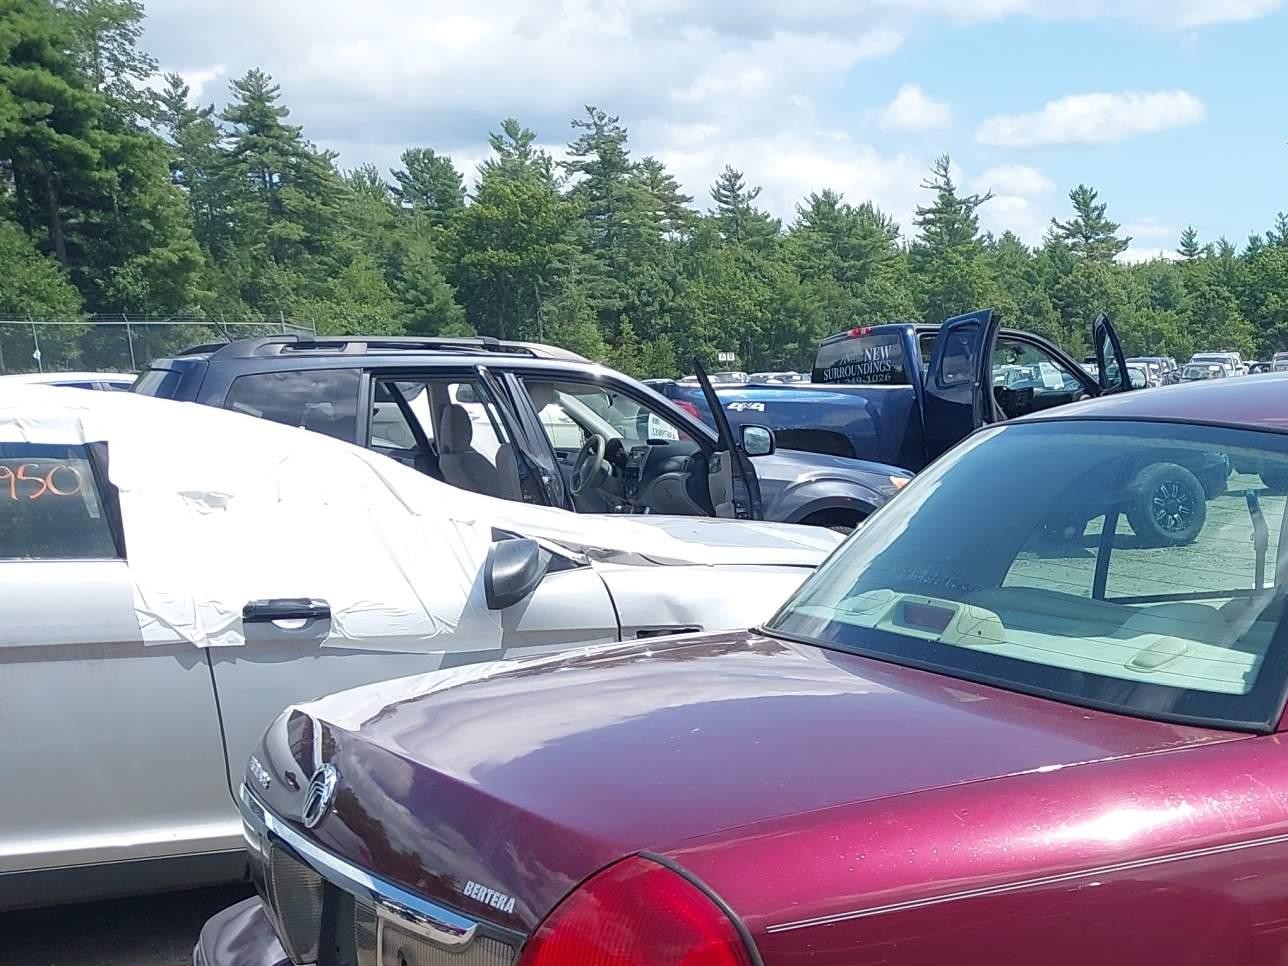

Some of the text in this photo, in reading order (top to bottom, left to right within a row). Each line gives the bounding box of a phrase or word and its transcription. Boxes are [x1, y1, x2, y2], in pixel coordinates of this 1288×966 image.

[864, 345, 892, 362] NEW
[823, 360, 892, 381] SURROUNDINGS
[463, 880, 516, 914] BERTERA
